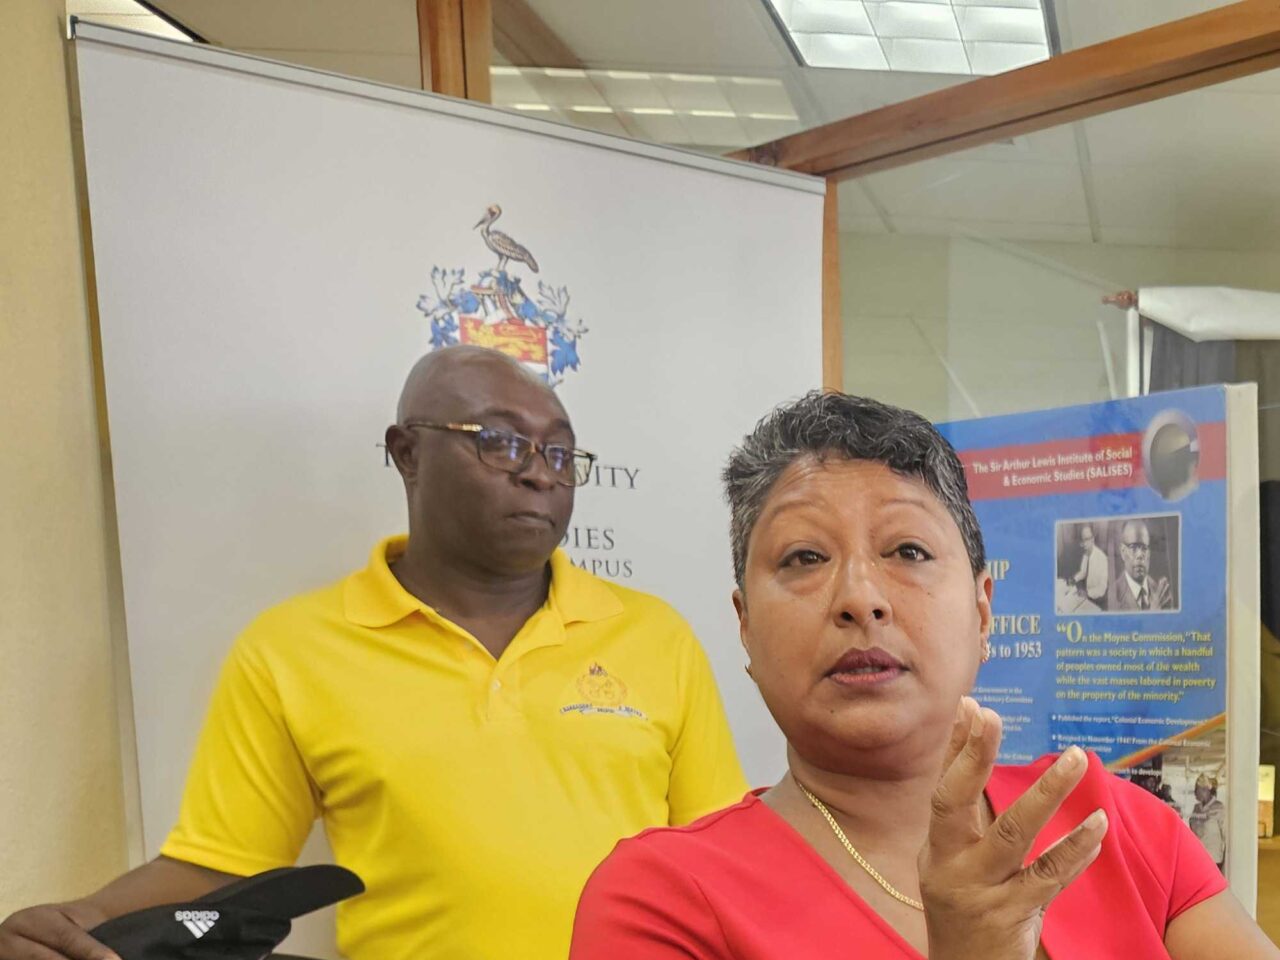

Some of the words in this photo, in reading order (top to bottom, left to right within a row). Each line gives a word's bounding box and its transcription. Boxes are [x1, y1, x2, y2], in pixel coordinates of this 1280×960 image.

[973, 461, 988, 474] The
[990, 461, 1001, 473] Sir
[1003, 458, 1030, 471] Arthur
[1033, 456, 1056, 468] Lewis
[1058, 452, 1093, 466] Institute
[1095, 450, 1105, 462] of
[1106, 446, 1133, 460] Social
[1003, 476, 1010, 487] &
[1012, 472, 1051, 487] Economic
[1054, 468, 1084, 482] Studies
[1086, 463, 1133, 481] (SALISES)
[1089, 632, 1101, 642] the
[1103, 632, 1130, 645] Moyne
[1000, 643, 1011, 658] to
[1015, 641, 1042, 658] 1953
[1056, 647, 1085, 659] pattern
[1086, 649, 1101, 657] was
[1102, 649, 1108, 657] a
[1109, 647, 1137, 659] society
[1139, 647, 1147, 657] in
[1149, 647, 1173, 657] which
[1174, 649, 1180, 657] a
[1181, 646, 1214, 657] handful
[1056, 661, 1065, 671] of
[1096, 662, 1122, 672] owned
[1123, 662, 1144, 672] most
[1146, 661, 1156, 672] of
[1157, 662, 1170, 672] the
[1172, 662, 1200, 672] wealth
[1056, 675, 1077, 685] while
[1078, 675, 1090, 685] the
[1092, 676, 1108, 686] vast
[1110, 677, 1139, 686] masses
[1140, 676, 1171, 686] labored
[1173, 676, 1181, 686] in
[1183, 677, 1217, 689] poverty
[1056, 690, 1066, 699] on
[1067, 689, 1081, 699] the
[1082, 690, 1115, 702] property
[1117, 690, 1127, 700] of
[1128, 690, 1142, 700] the
